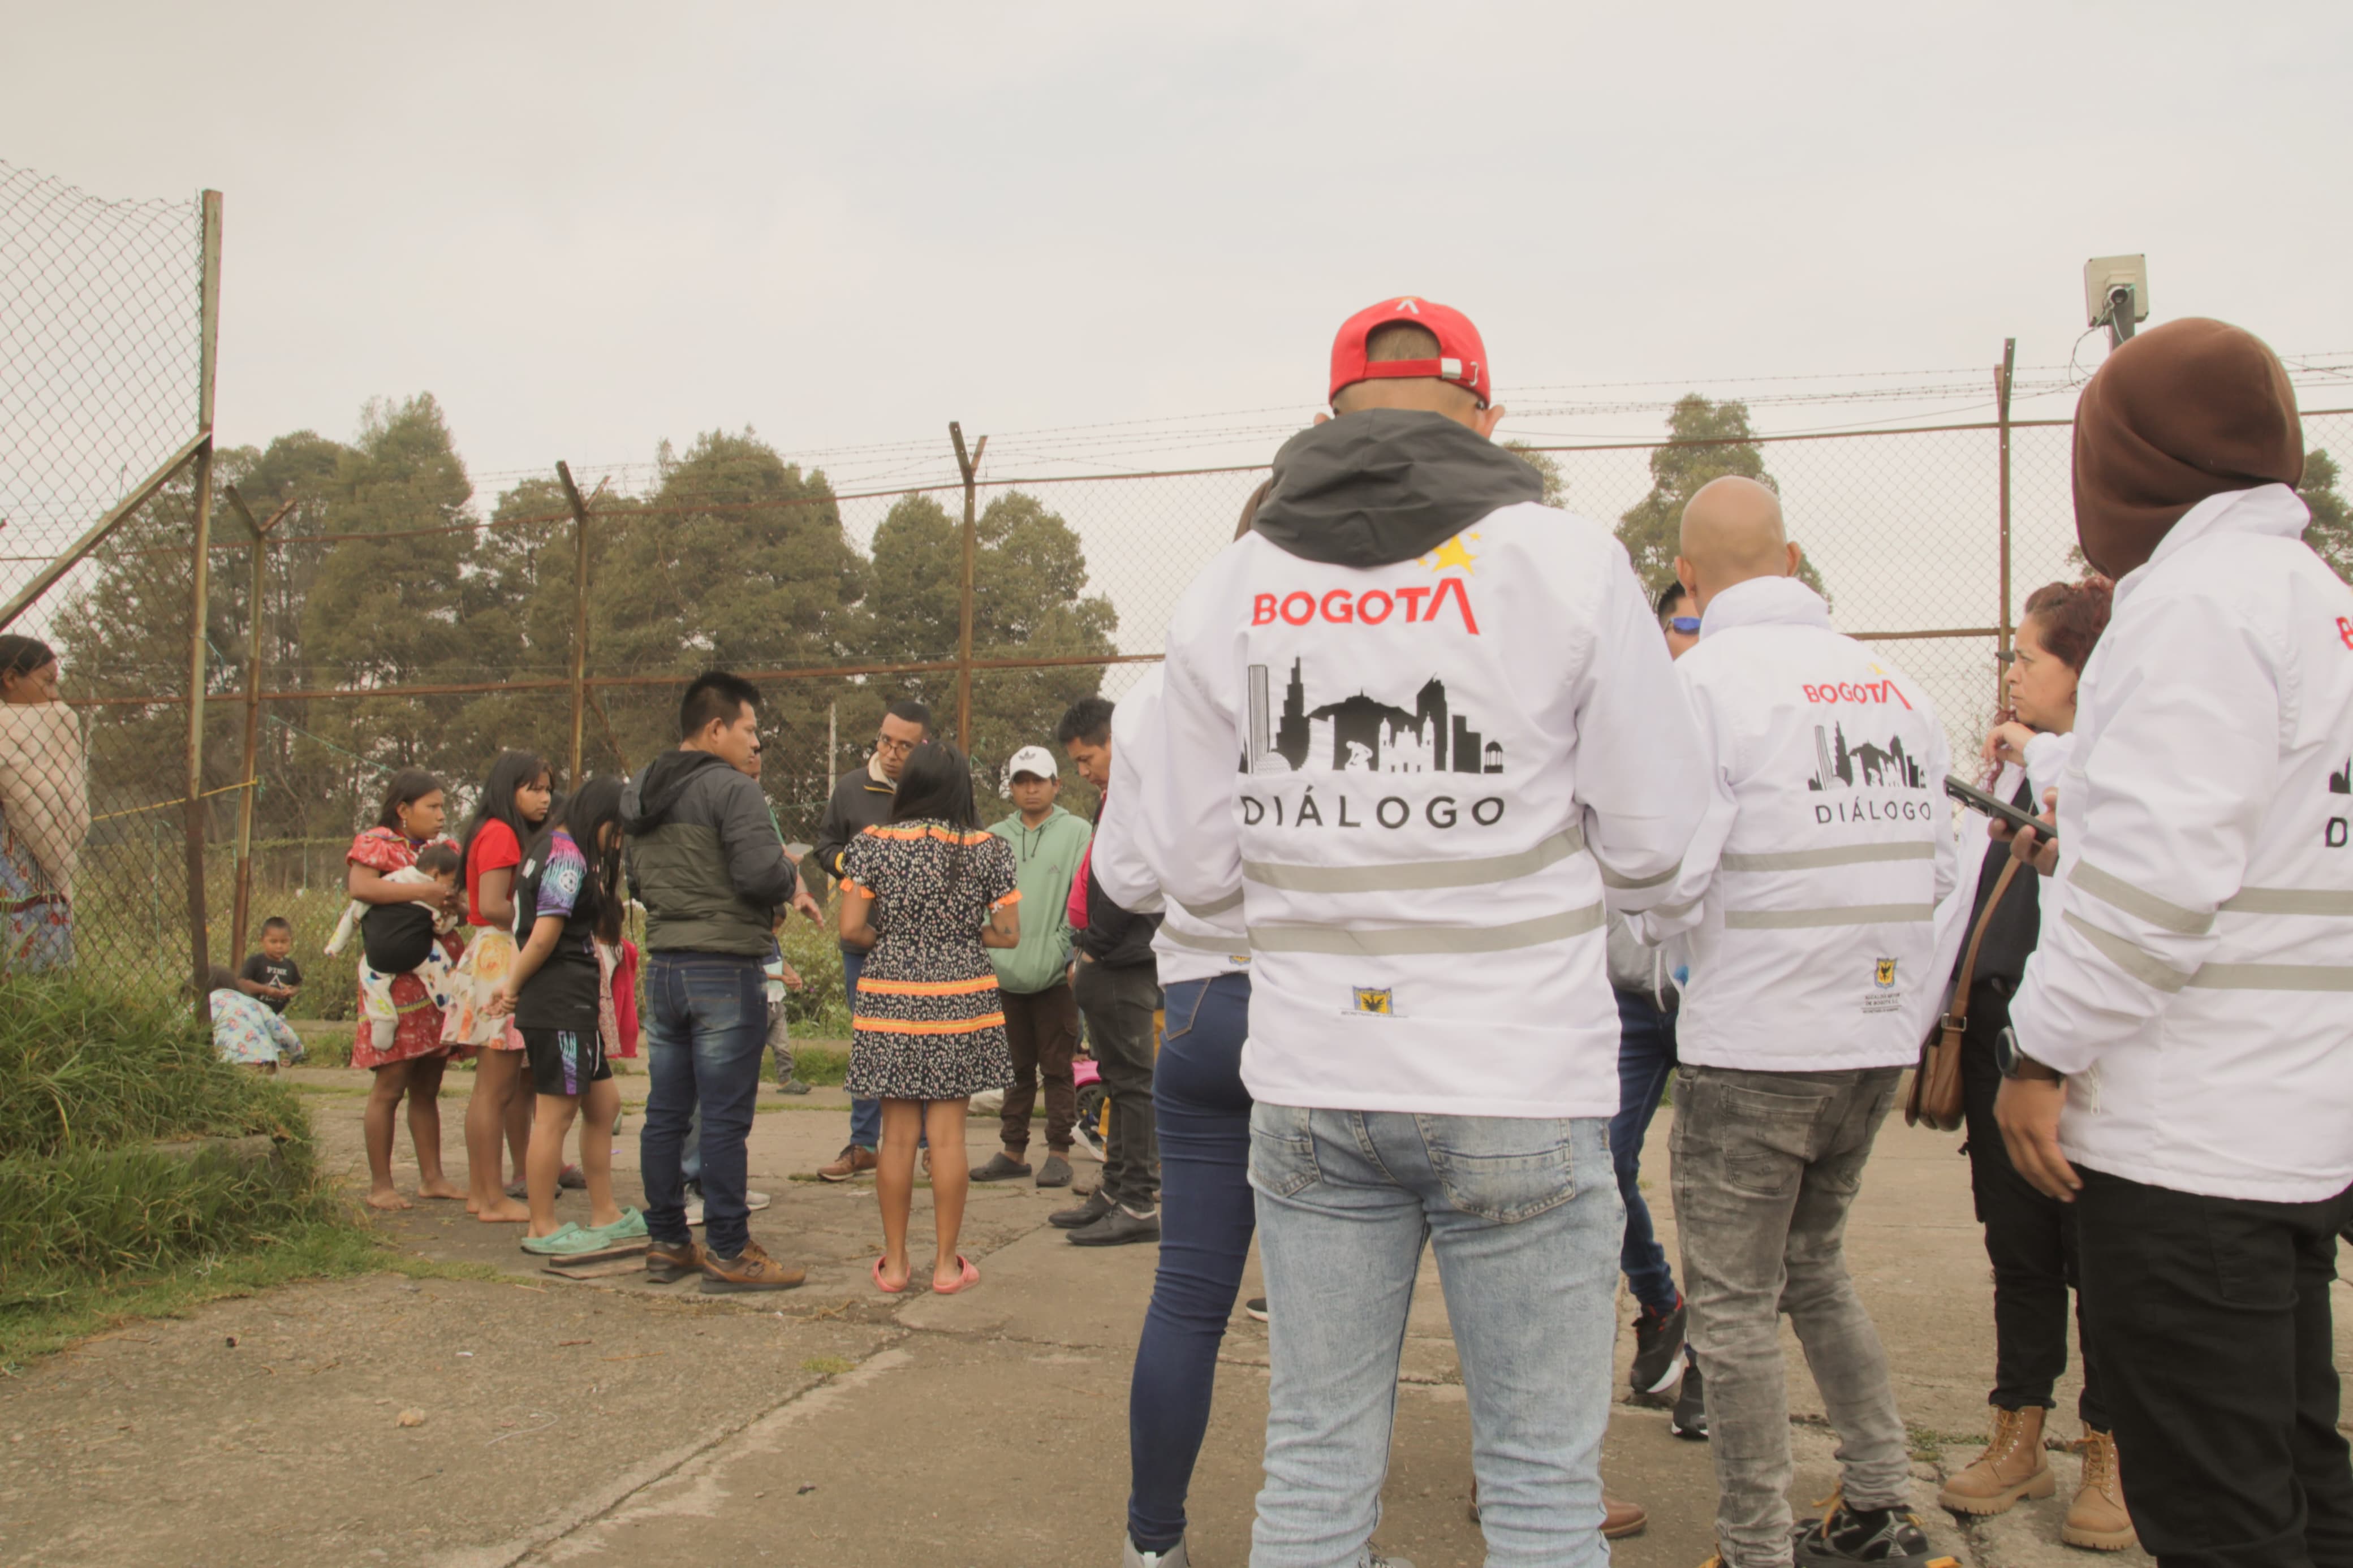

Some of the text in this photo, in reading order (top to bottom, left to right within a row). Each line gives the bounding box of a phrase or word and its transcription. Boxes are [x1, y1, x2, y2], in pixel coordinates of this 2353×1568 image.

[1240, 785, 1505, 830] DIÁLOGO
[1815, 796, 1931, 824] DIÁLOGO
[266, 966, 287, 976] PINK
